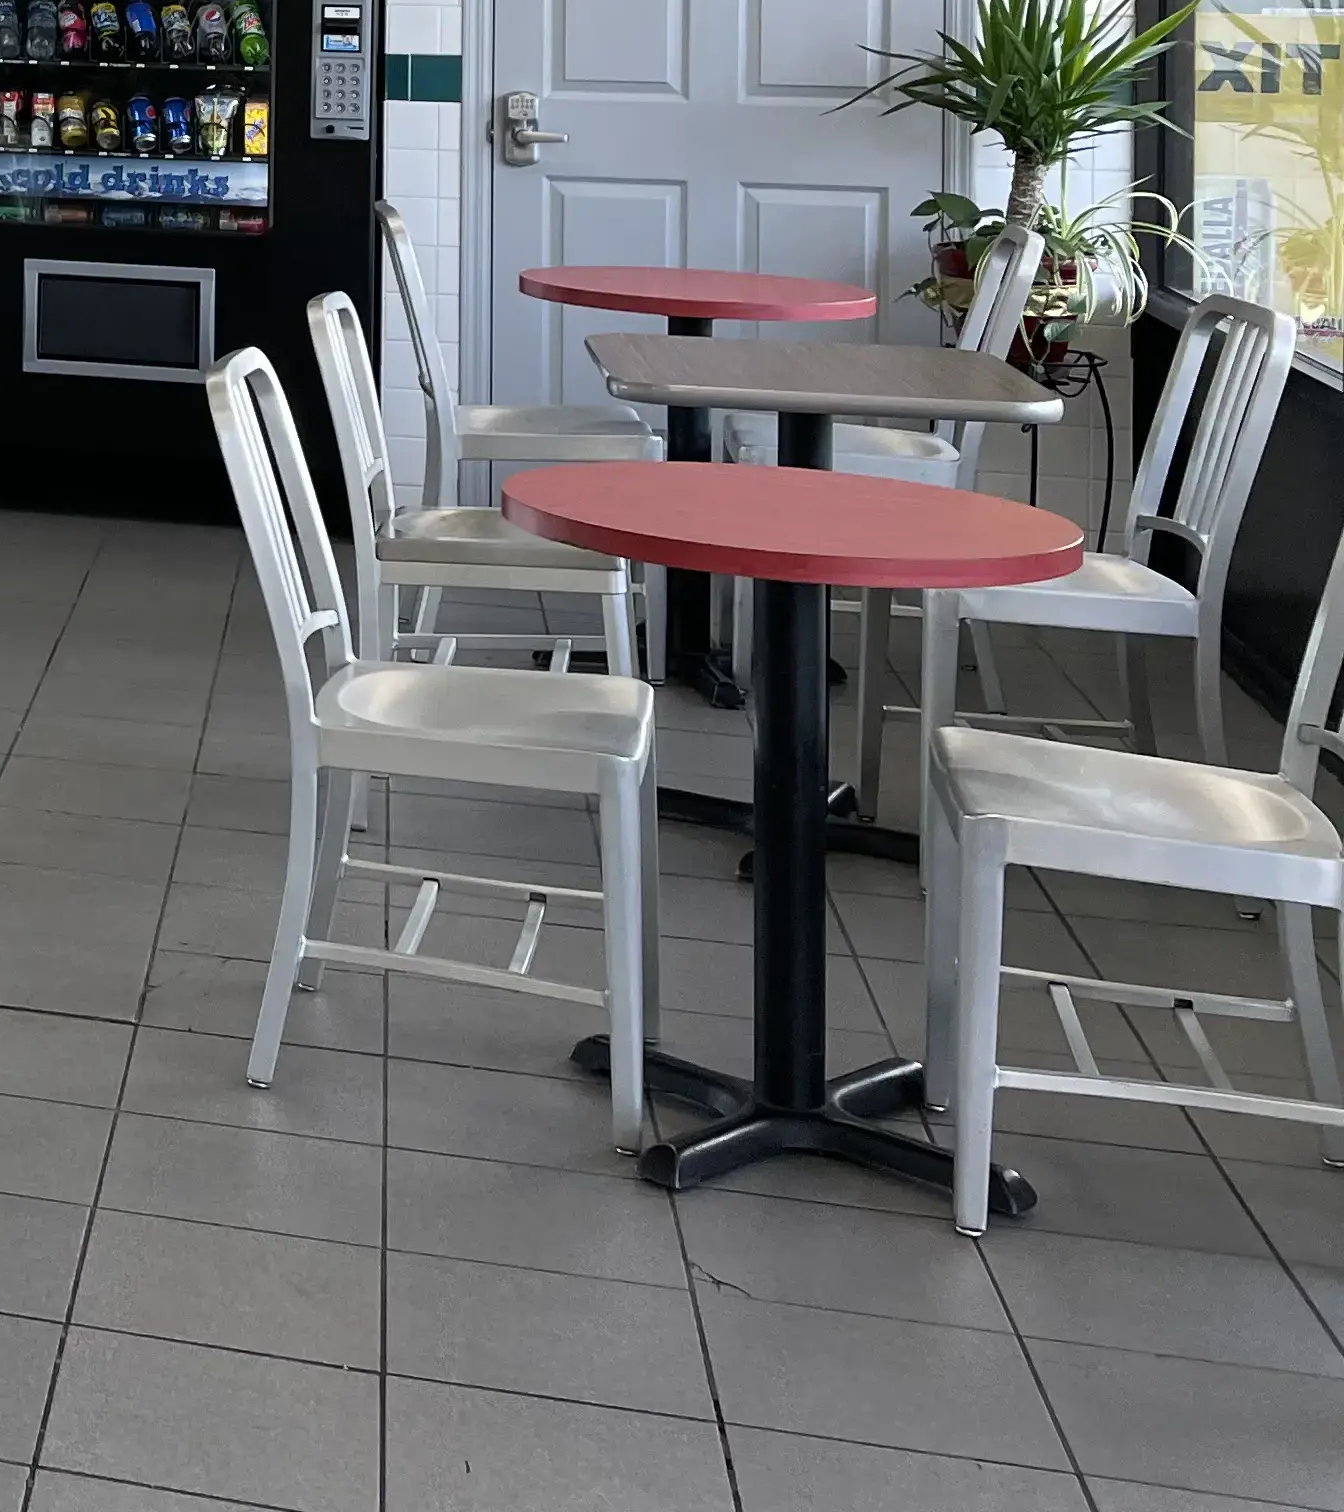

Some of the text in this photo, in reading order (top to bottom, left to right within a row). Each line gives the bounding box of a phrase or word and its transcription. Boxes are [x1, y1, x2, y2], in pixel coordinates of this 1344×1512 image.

[1197, 41, 1341, 95] XIT
[12, 163, 229, 197] cold drinks
[1201, 197, 1234, 293] EALLA
